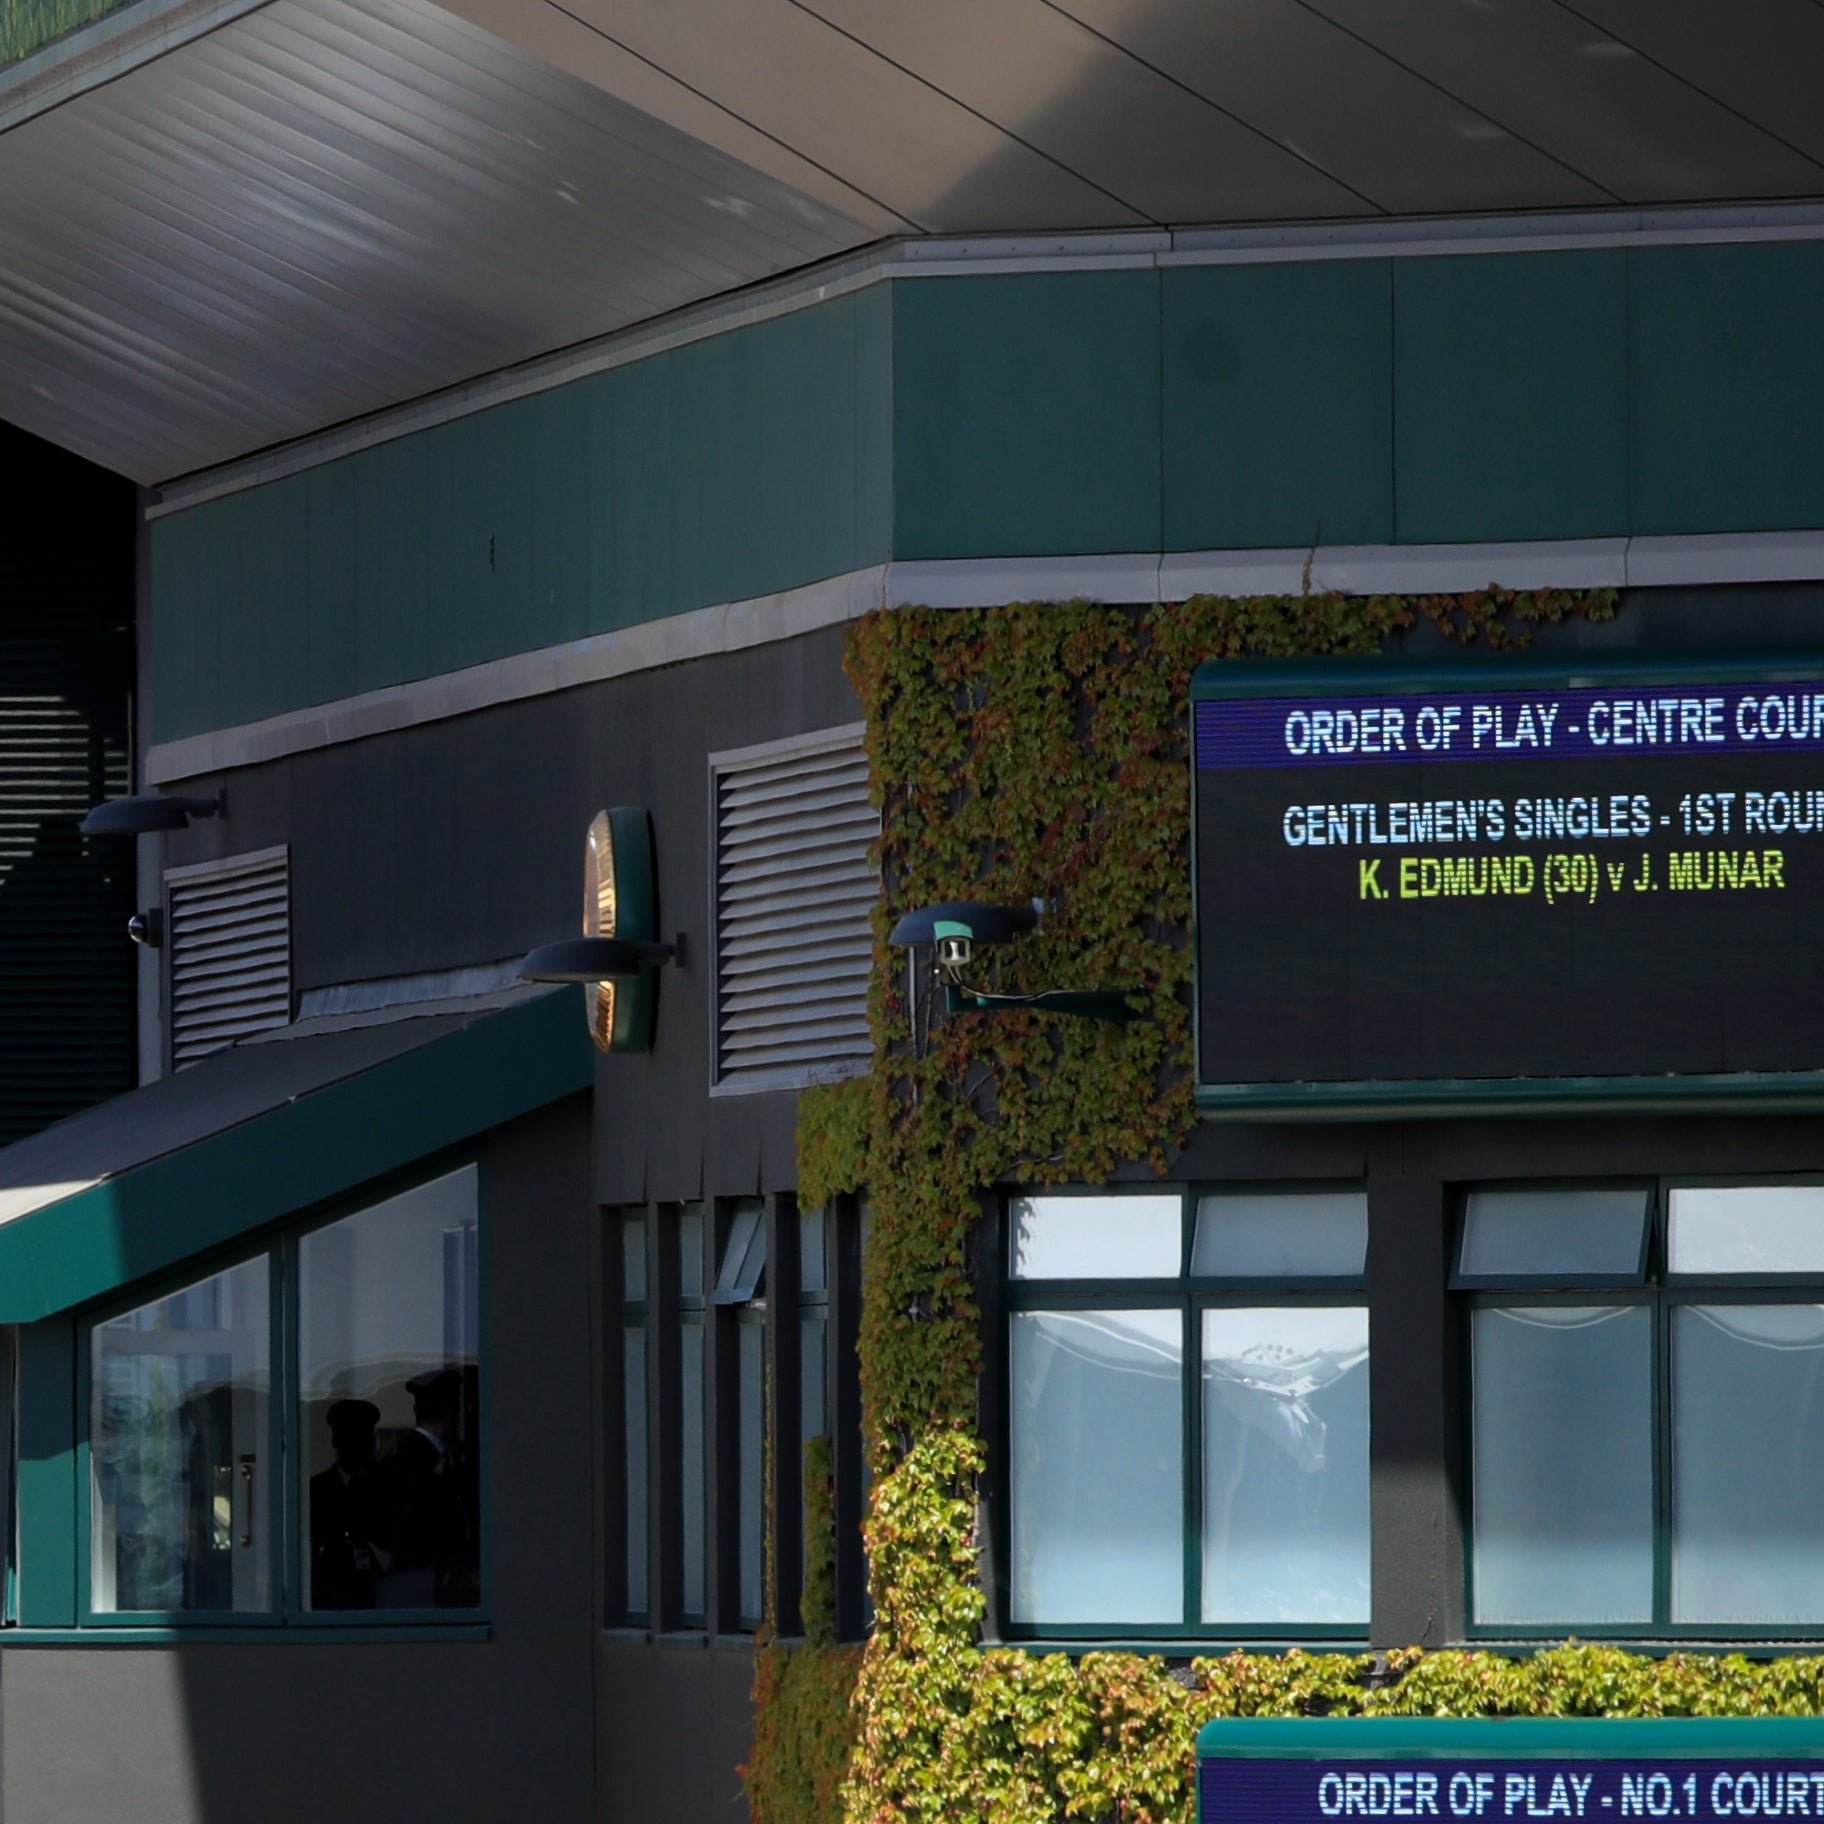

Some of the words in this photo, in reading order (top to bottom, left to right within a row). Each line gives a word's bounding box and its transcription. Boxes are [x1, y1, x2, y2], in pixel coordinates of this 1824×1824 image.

[1284, 708, 1407, 755] ORDER
[1415, 706, 1461, 750] OF
[1472, 703, 1560, 748] PLAY
[1588, 698, 1725, 745] CENTRE
[1283, 799, 1505, 846] GENTLEMEN'S
[1514, 795, 1651, 840] SINGLES
[1679, 792, 1736, 835] 1ST
[1359, 859, 1389, 899] K.
[1400, 855, 1535, 898] EDMUND
[1543, 853, 1598, 904] (30)
[1606, 862, 1624, 891] v
[1633, 853, 1658, 891] J.
[1669, 850, 1786, 890] MUNAR
[1318, 1772, 1439, 1815] ORDER
[1449, 1772, 1495, 1815] OF
[1505, 1772, 1593, 1816] PLAY
[1621, 1772, 1696, 1815] NO.1
[1711, 1772, 1824, 1815] COURT
